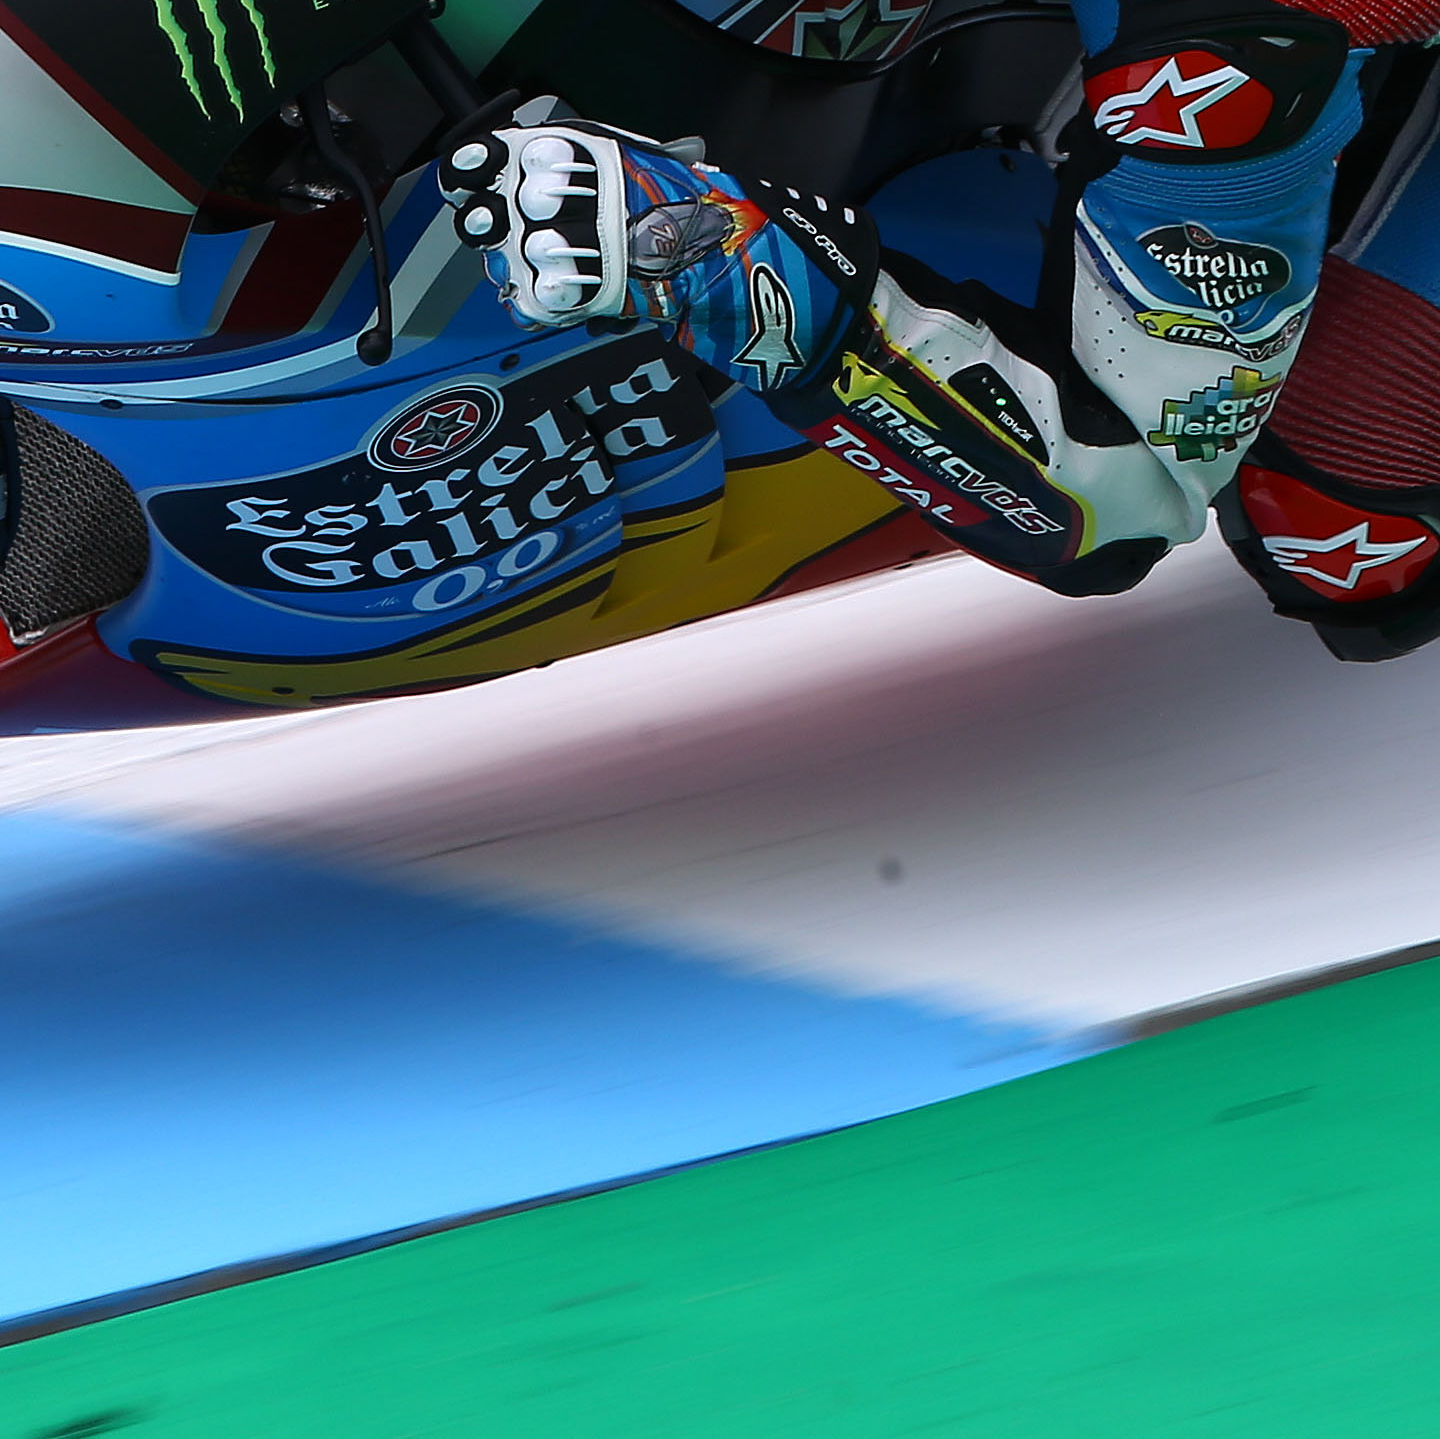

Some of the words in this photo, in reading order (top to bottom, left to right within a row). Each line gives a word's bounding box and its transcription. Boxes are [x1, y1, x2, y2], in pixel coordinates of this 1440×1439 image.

[1164, 412, 1257, 437] lleida
[1217, 391, 1272, 415] ara
[262, 415, 677, 588] Galicia
[824, 424, 955, 524] TOTAL
